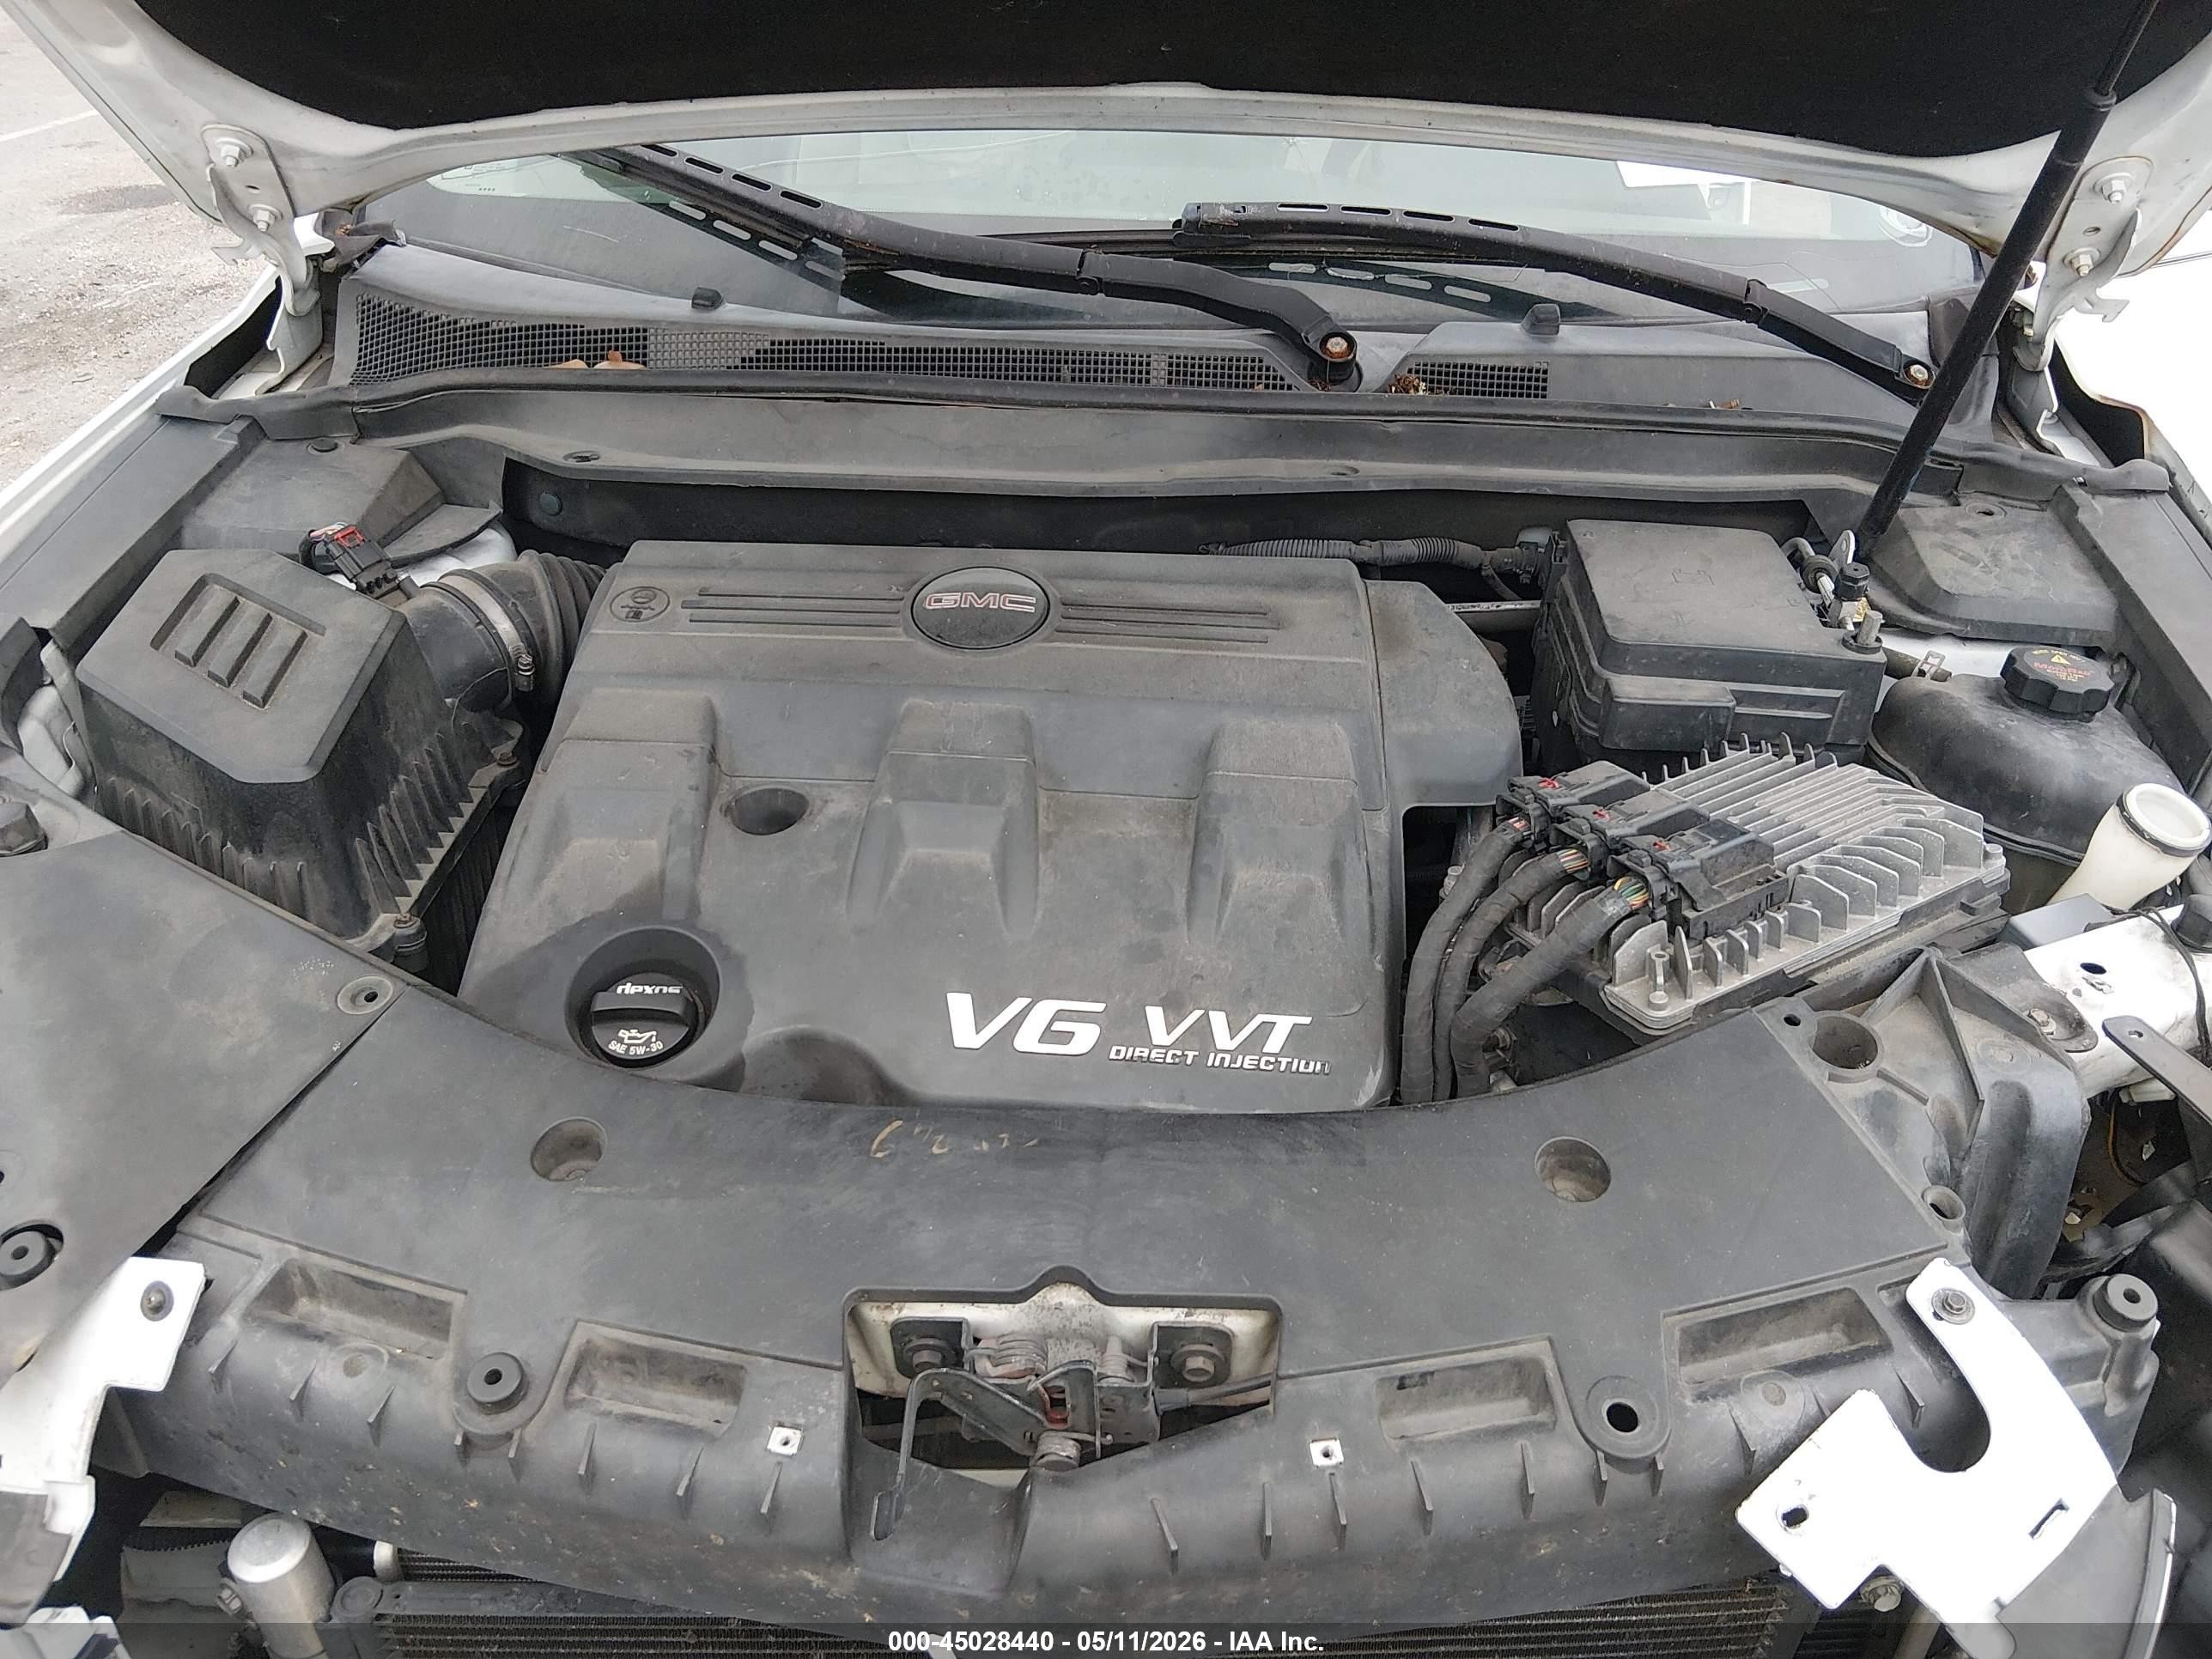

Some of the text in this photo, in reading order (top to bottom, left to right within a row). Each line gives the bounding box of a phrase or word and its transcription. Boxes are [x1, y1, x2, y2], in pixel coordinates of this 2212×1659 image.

[925, 592, 1036, 613] GMC
[946, 992, 1313, 1055] V6 VVT
[608, 1040, 664, 1055] SAE 5W-30
[1109, 1045, 1330, 1074] DIRECT INJECTION
